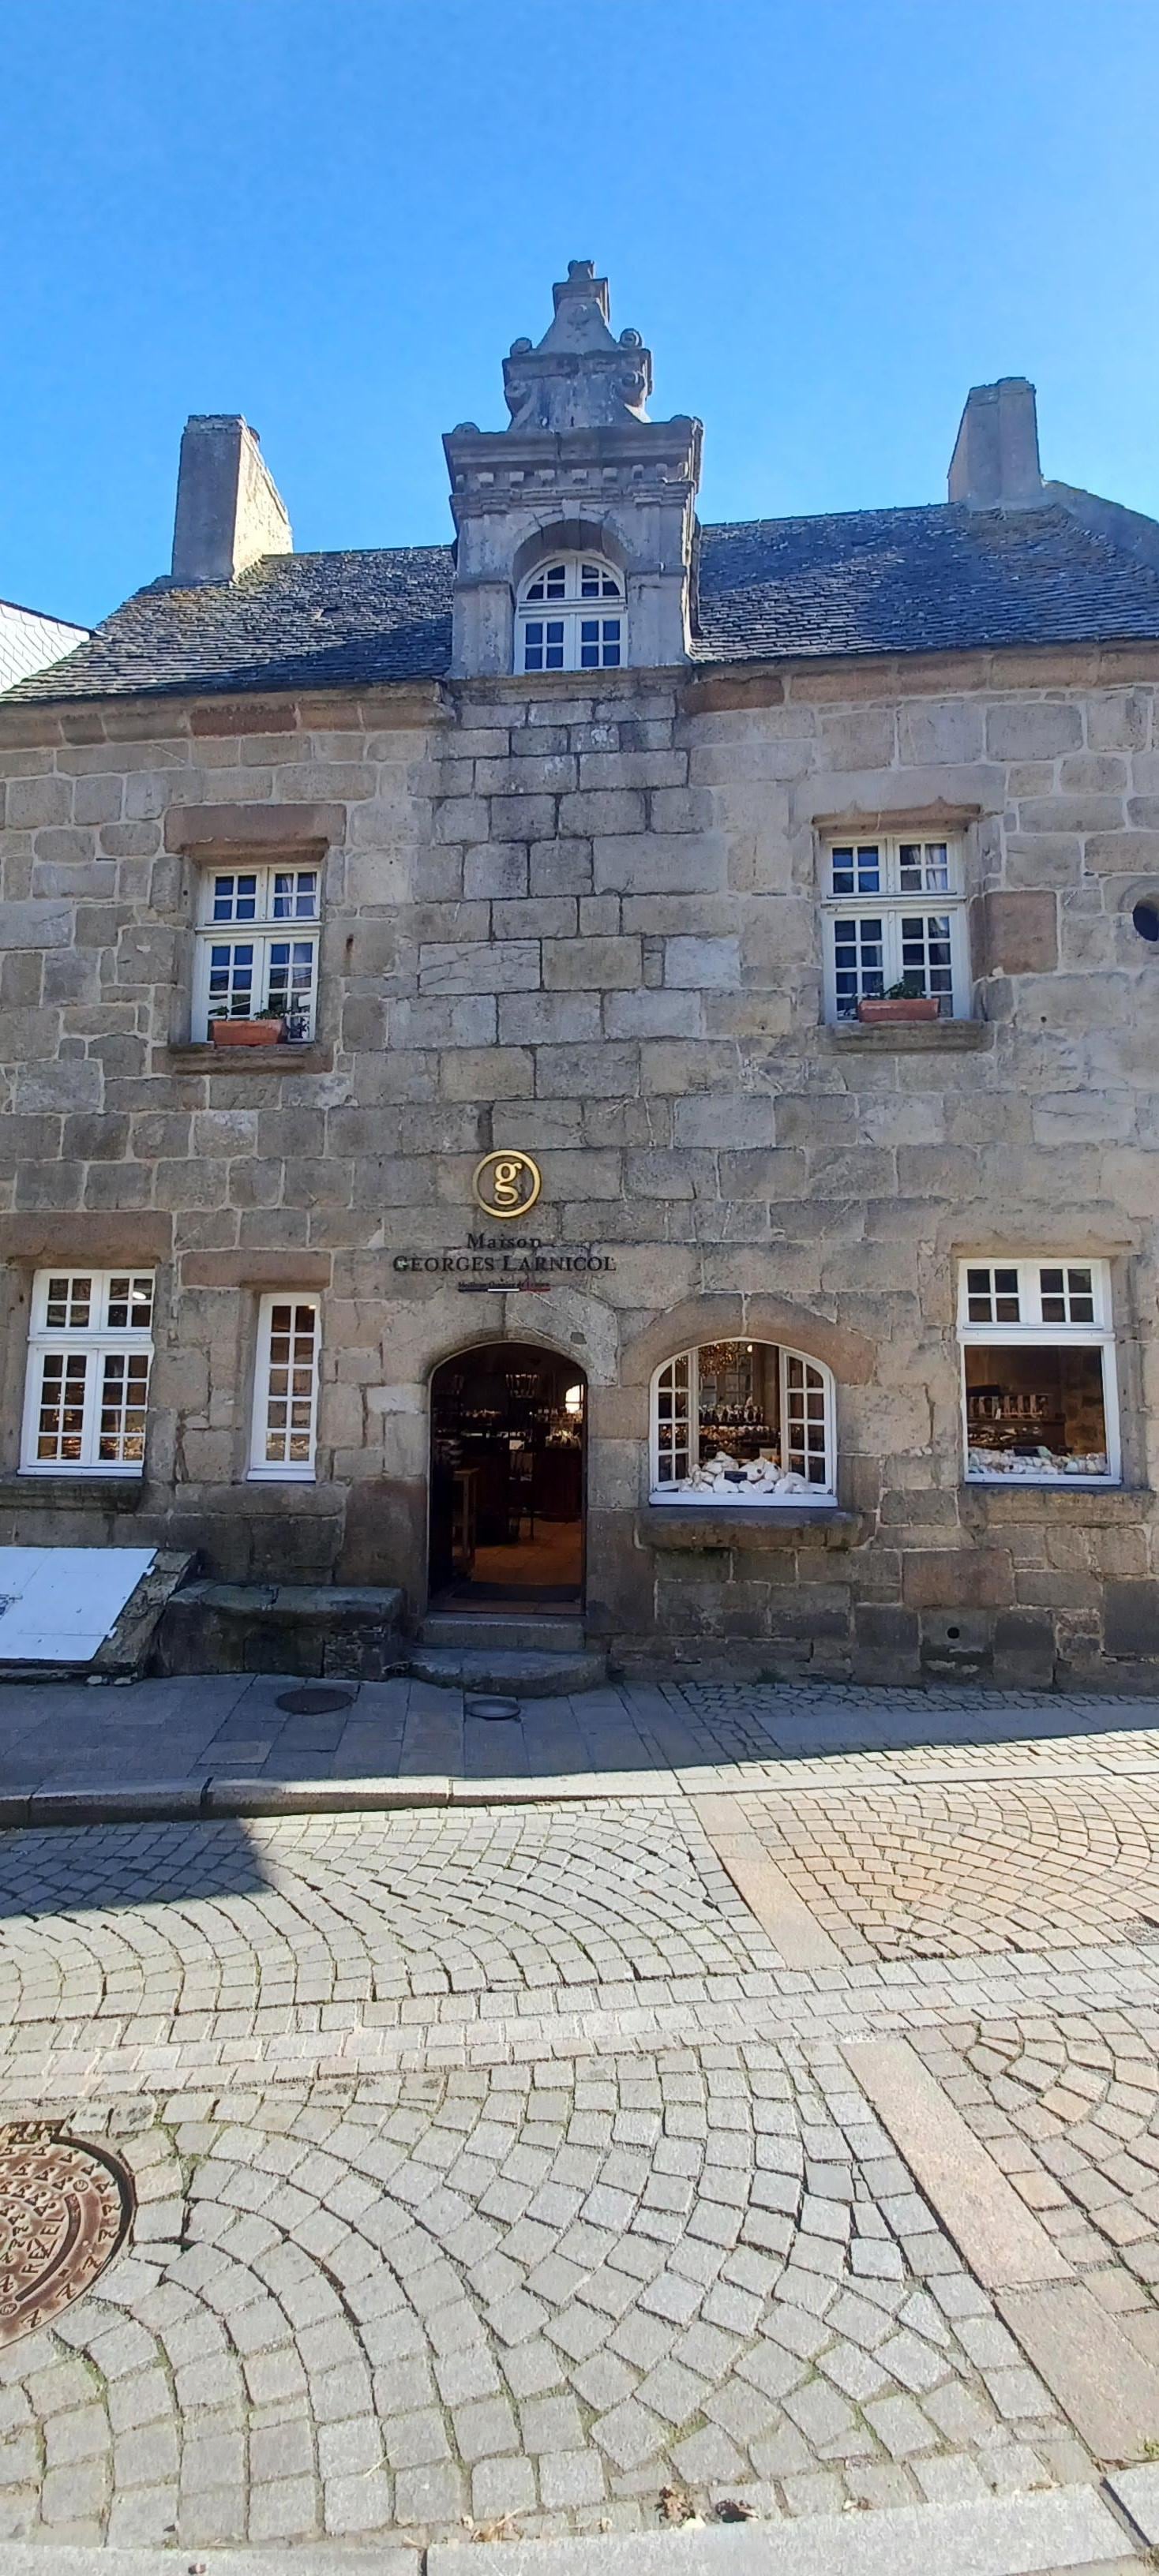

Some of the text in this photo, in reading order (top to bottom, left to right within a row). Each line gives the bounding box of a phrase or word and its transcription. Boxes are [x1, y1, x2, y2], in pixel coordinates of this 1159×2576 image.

[494, 1163, 523, 1205] g
[467, 1233, 542, 1249] Maison
[393, 1254, 617, 1272] GEORGES LARNICOL
